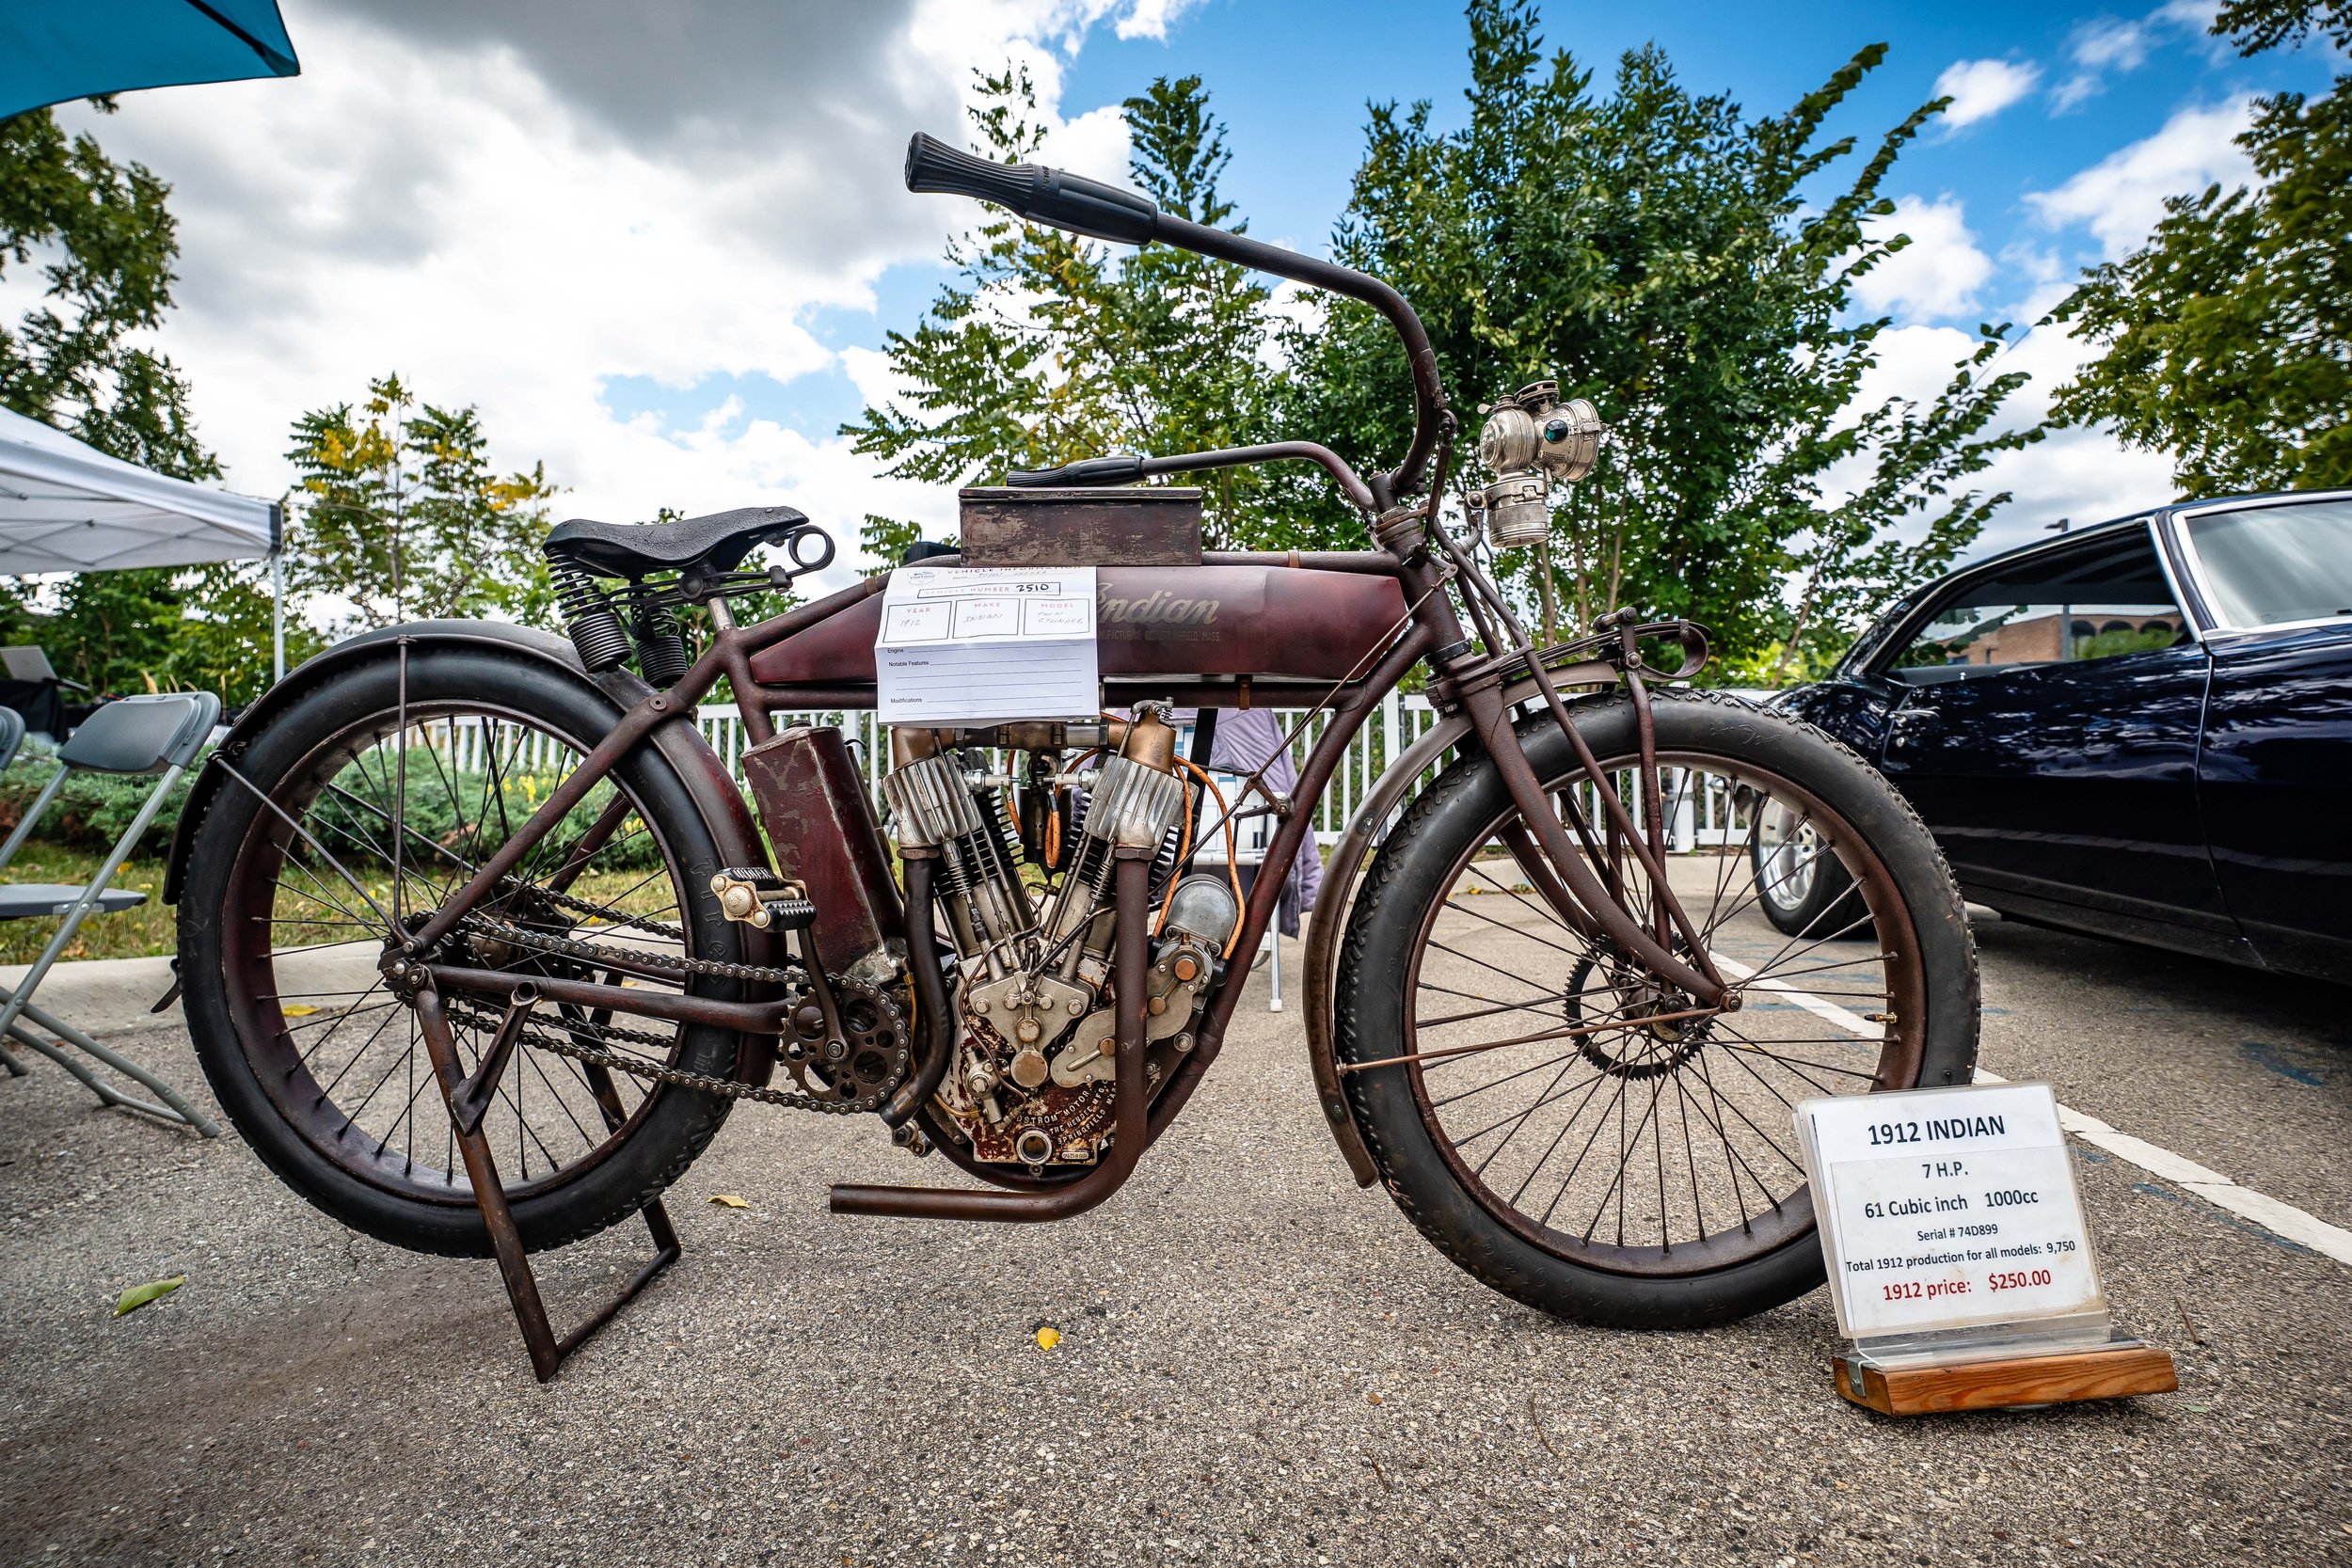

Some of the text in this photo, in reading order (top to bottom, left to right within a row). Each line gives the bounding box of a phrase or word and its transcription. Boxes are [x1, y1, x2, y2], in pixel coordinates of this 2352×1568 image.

[1016, 583, 1049, 593] 2510
[899, 619, 921, 627] 1912
[963, 613, 1003, 623] INDIAN
[1049, 1125, 1065, 1134] THE
[1057, 1109, 1106, 1145] SPRINGFIELD
[1867, 1116, 2006, 1146] 1912 INDIAN
[1922, 1161, 1969, 1179] 7 H.P.
[1865, 1189, 2039, 1218] 61 Cubic inch 1000cc
[1917, 1224, 1998, 1242] Serial # 74D899
[1846, 1240, 2076, 1273] Total 1912 production for all models: 9,750
[1883, 1269, 2052, 1301] 1912 price: $250.00
